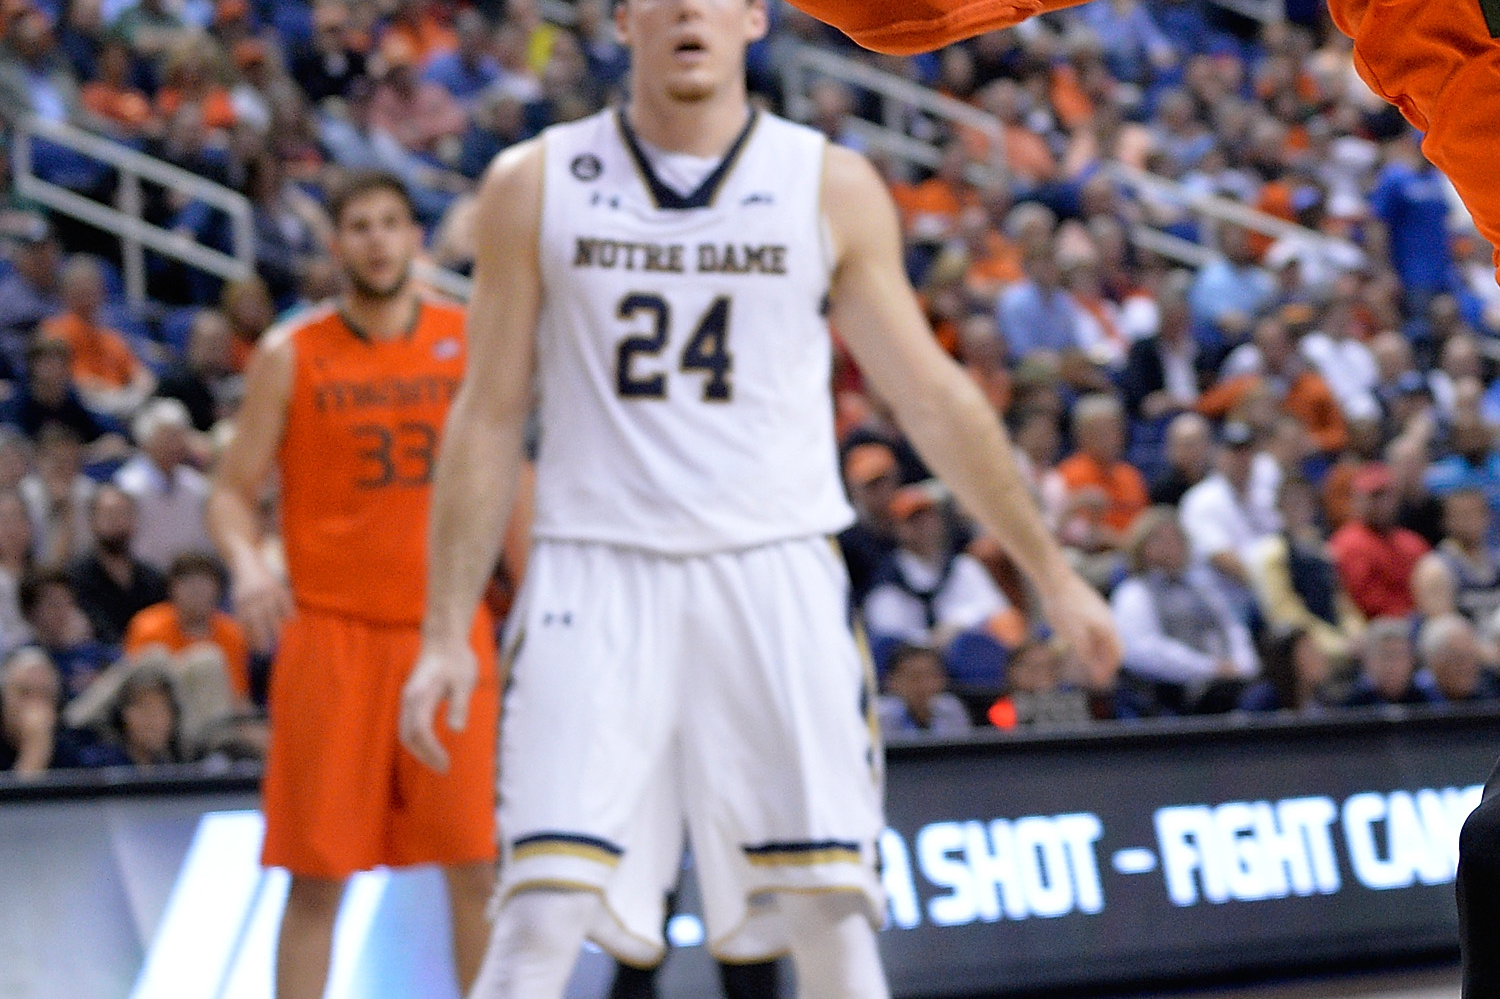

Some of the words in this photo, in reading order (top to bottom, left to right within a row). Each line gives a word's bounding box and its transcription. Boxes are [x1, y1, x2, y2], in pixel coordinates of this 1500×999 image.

[573, 237, 685, 276] NOTRE
[697, 243, 788, 277] DAME
[615, 291, 734, 402] 24
[351, 419, 438, 491] 33
[916, 811, 1104, 928] SHOT
[1152, 796, 1343, 907] FIGHT
